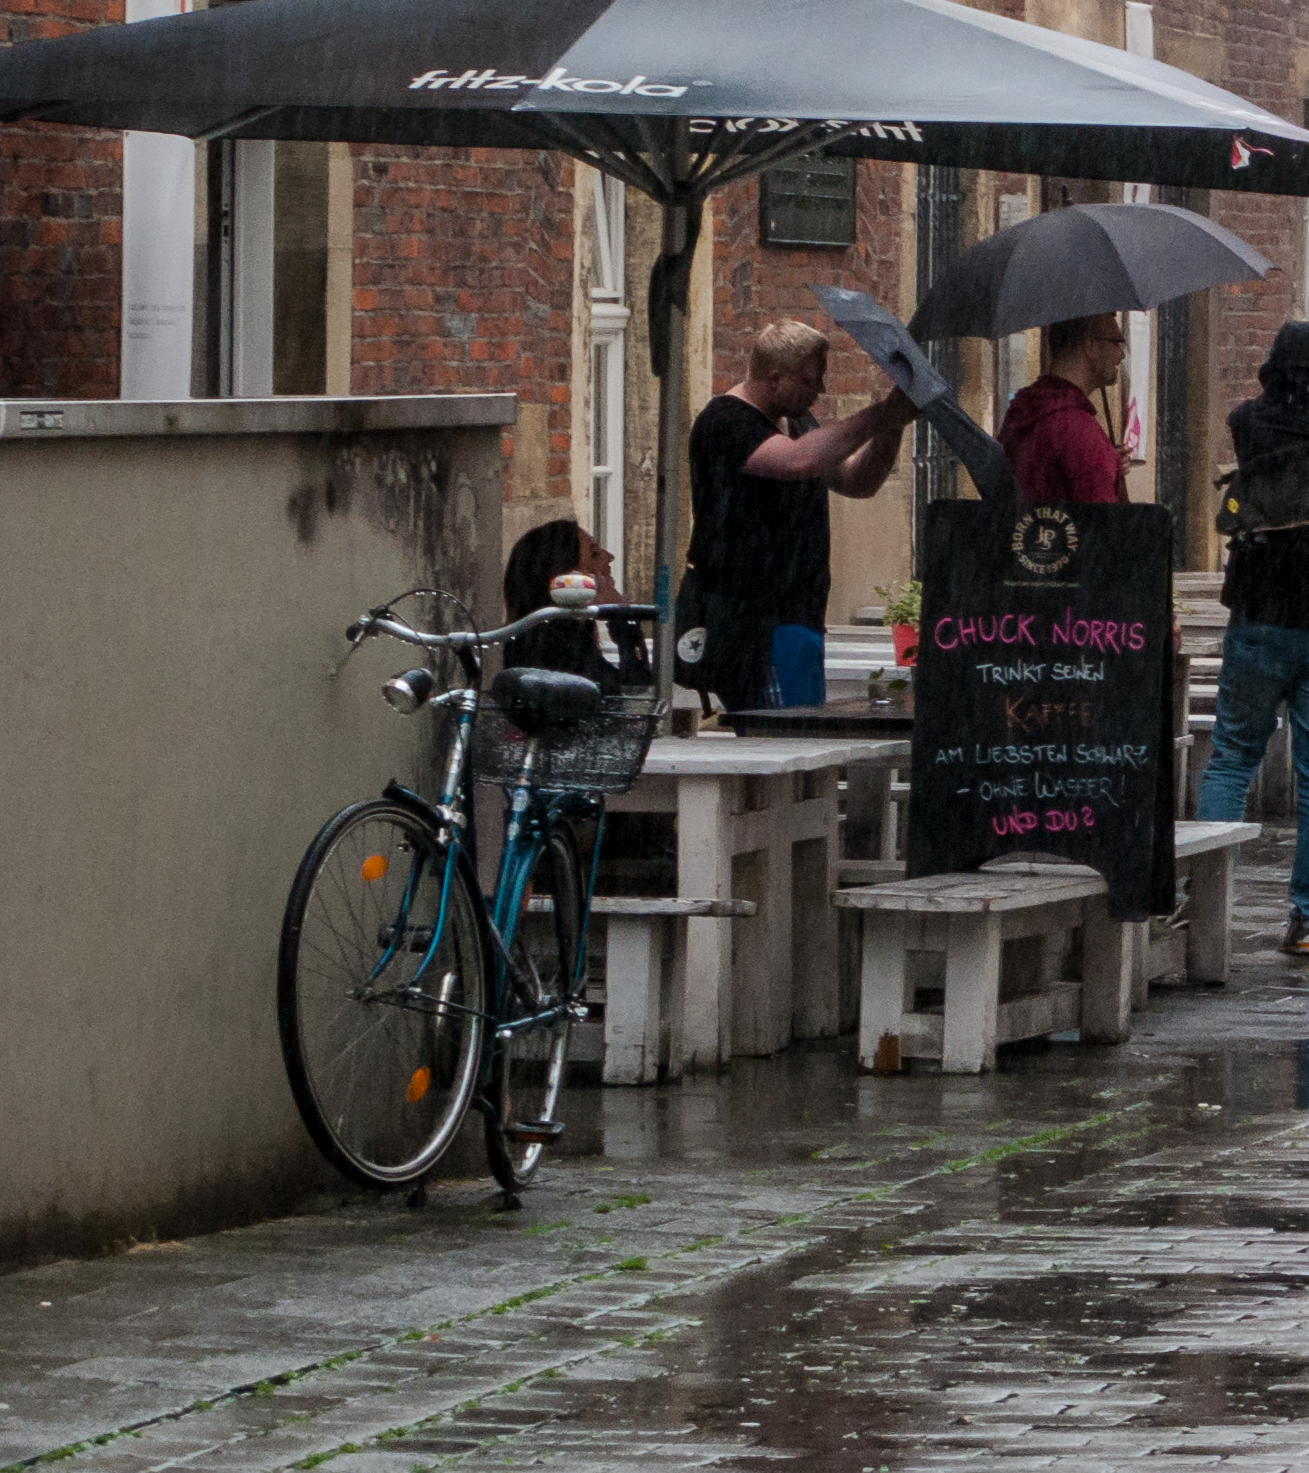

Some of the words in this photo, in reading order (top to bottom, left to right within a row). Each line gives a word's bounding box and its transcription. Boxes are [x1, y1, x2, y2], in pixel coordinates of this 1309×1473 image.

[408, 67, 688, 98] fritz-kola
[1012, 513, 1034, 551] BORN
[1034, 507, 1070, 524] THAT
[1064, 521, 1079, 553] WAY
[934, 613, 1037, 650] CHUCK
[1052, 606, 1147, 655] NORRIS
[976, 657, 1047, 686] TRINKT
[1050, 654, 1105, 682] SEINEN
[936, 747, 964, 764] AM
[975, 743, 1068, 765] LIEBSTEN
[979, 778, 1028, 801] OHNE
[992, 804, 1039, 836] UND
